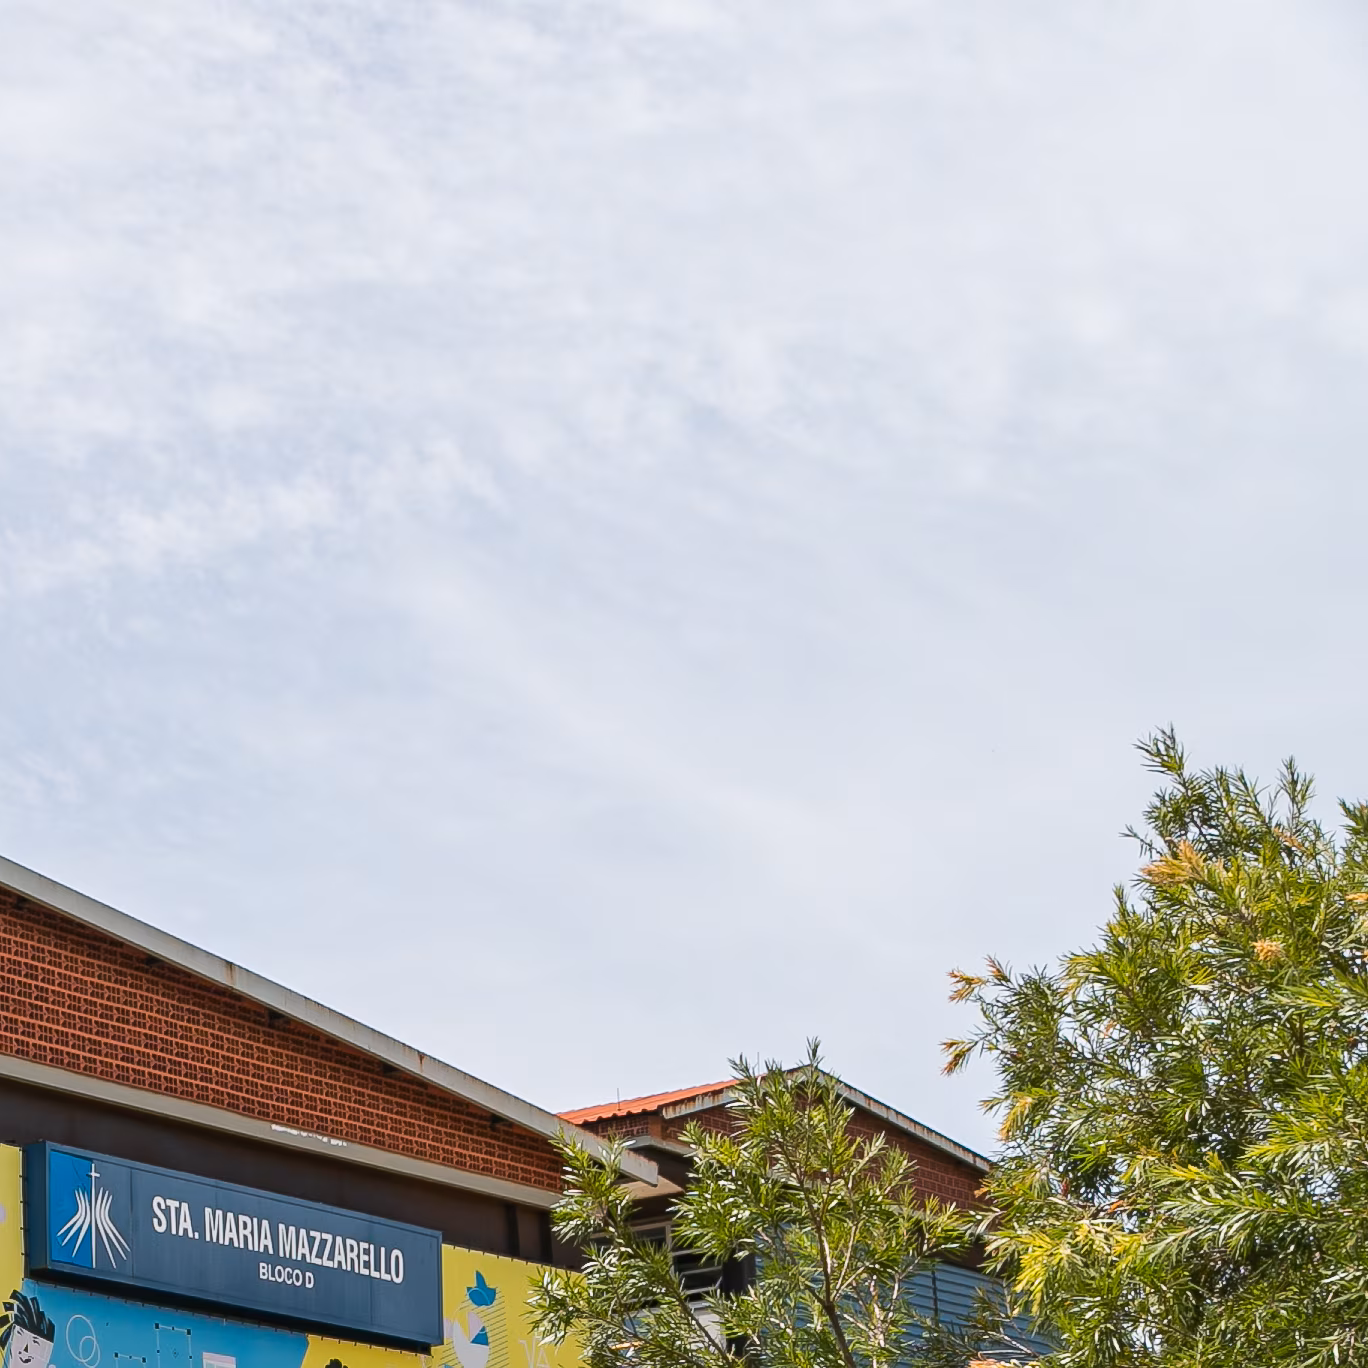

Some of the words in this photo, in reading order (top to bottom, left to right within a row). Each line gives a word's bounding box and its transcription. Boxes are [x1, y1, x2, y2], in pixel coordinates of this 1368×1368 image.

[152, 1196, 200, 1240] STA.
[204, 1206, 274, 1255] MARIA
[278, 1223, 405, 1284] MAZZARELLO
[259, 1262, 303, 1287] BLOCO
[305, 1271, 314, 1289] D
